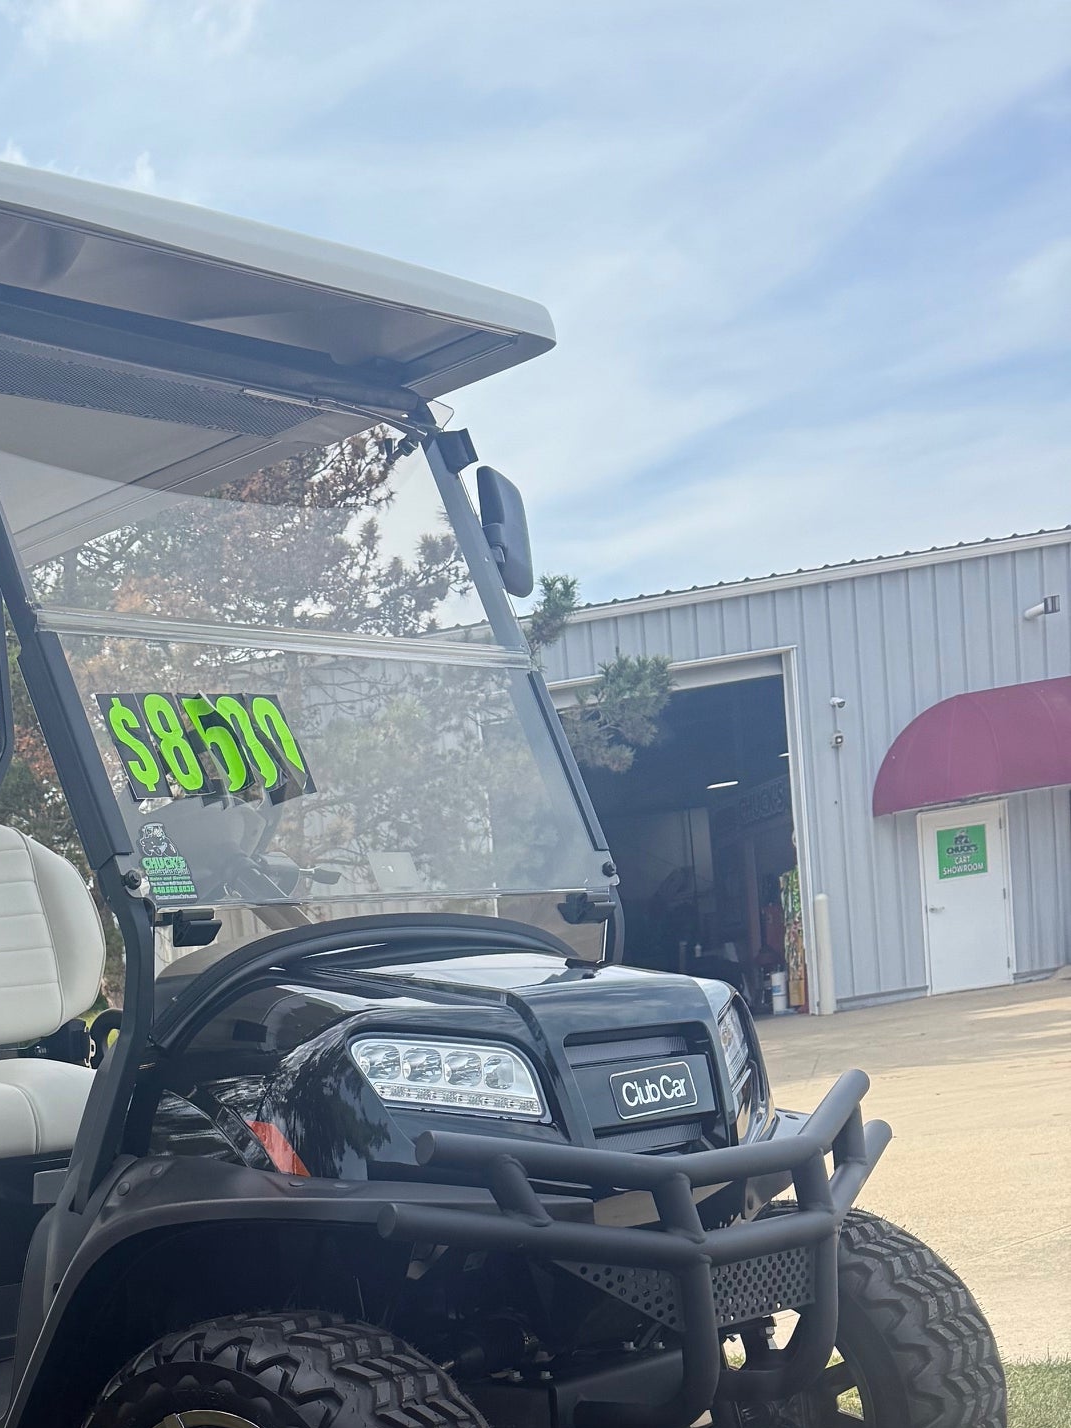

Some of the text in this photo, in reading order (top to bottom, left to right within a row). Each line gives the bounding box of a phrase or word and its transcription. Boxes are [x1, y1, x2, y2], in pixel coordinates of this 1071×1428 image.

[955, 855, 971, 865] CART
[942, 862, 984, 876] SHOWROOM
[622, 1074, 687, 1107] Club Car
